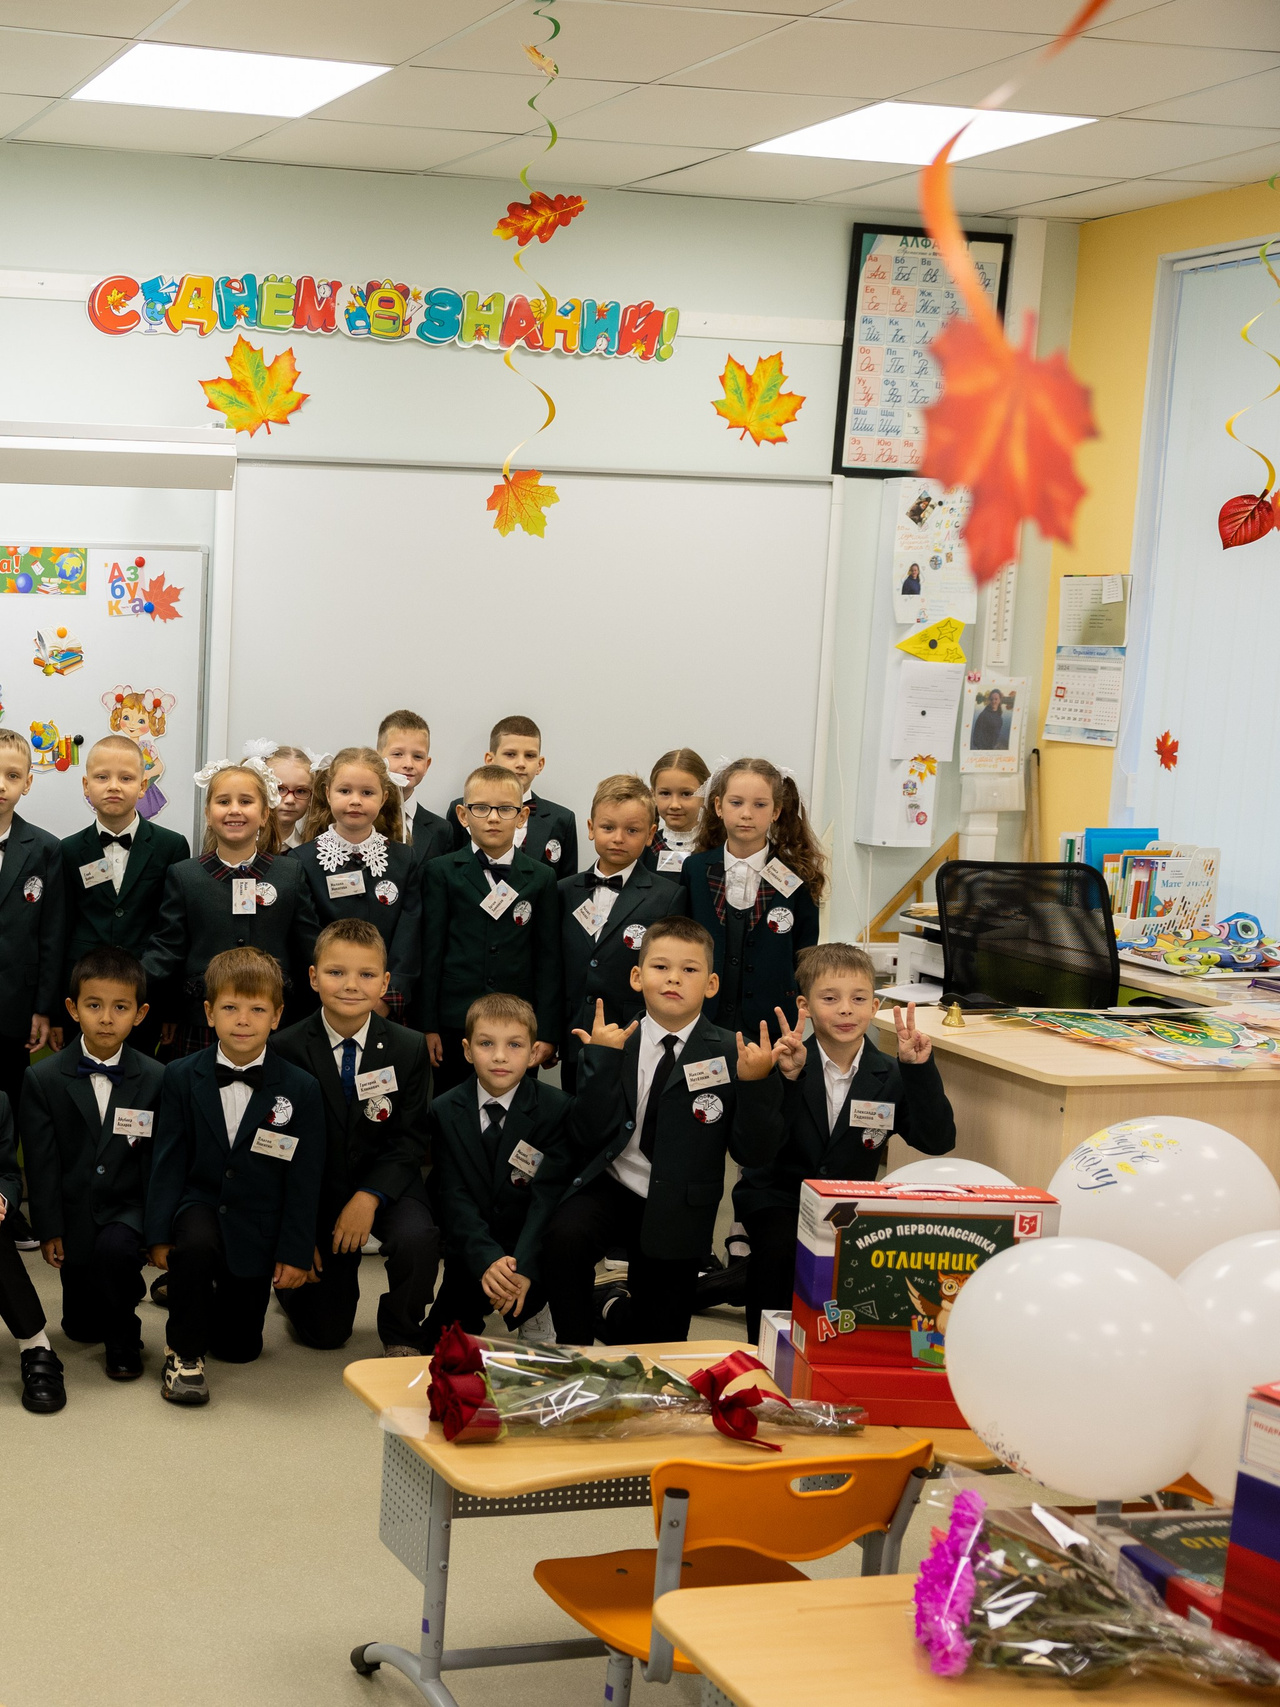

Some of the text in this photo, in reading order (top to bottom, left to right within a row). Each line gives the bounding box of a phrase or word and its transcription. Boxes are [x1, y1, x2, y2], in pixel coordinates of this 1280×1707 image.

[899, 236, 972, 251] АЛФАТ
[895, 256, 905, 264] Бб
[891, 287, 900, 295] Ёё
[90, 272, 680, 363] С ДНЁМ ЗНАНИЙ!
[913, 350, 923, 358] Рр
[883, 379, 896, 387] Фф
[910, 380, 918, 388] Хх
[359, 1080, 377, 1088] Григорий
[1021, 1217, 1037, 1234] 5+
[855, 1224, 996, 1253] НАБОР ПЕРВОКЛАССНИКА
[870, 1250, 980, 1271] ОТЛИЧНИК
